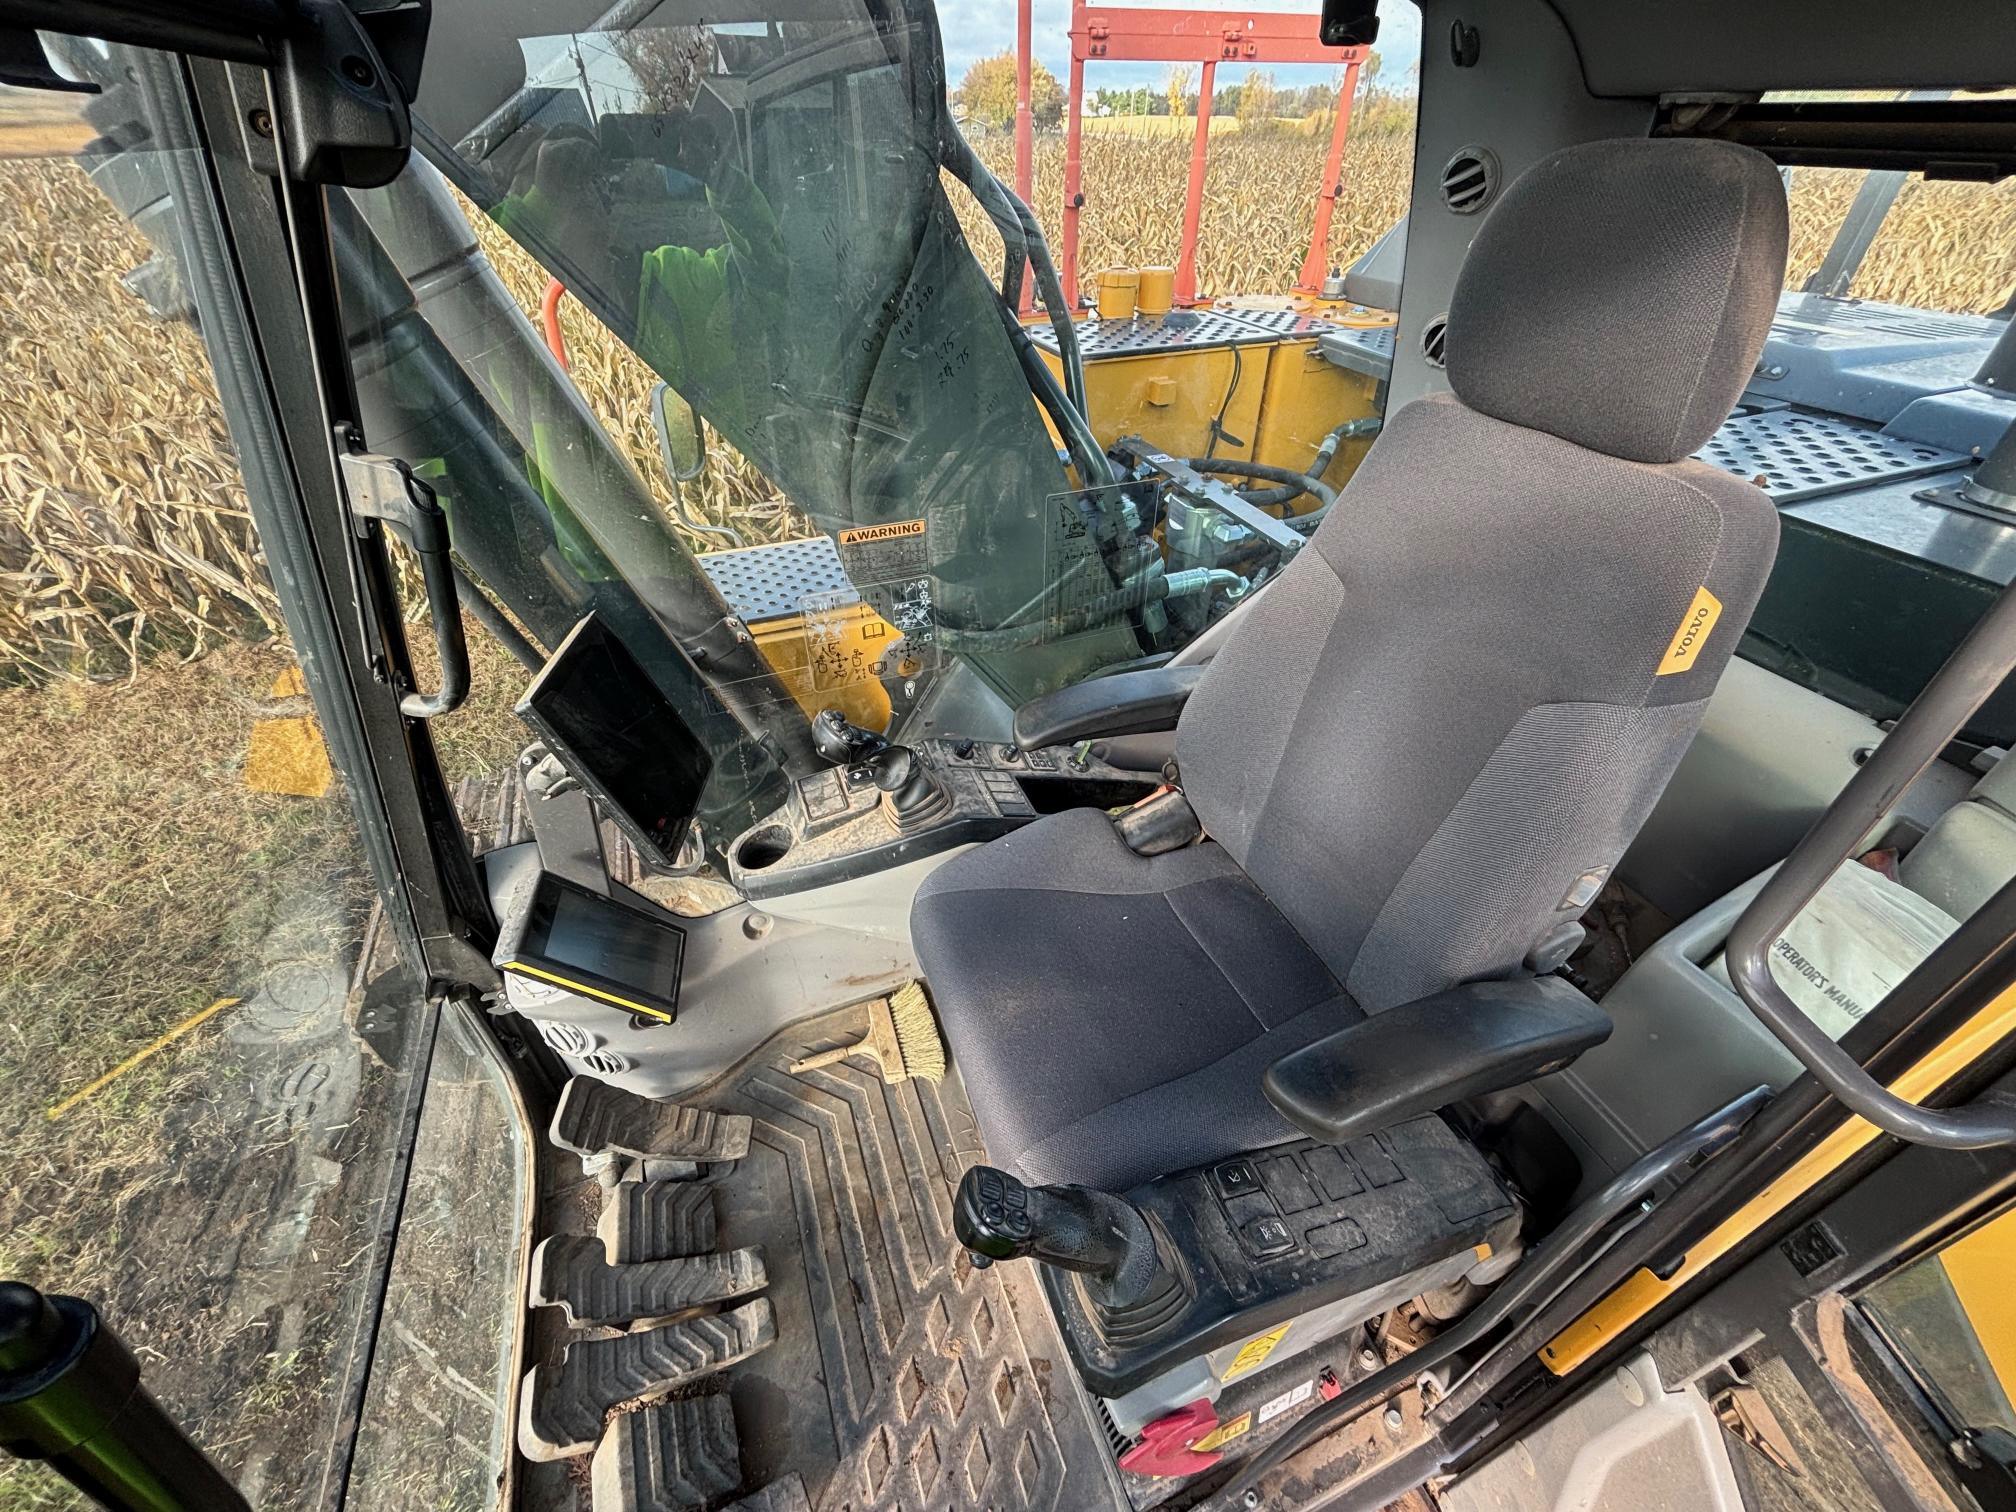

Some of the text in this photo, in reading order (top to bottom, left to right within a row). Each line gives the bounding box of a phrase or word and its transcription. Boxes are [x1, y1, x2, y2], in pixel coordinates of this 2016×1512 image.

[857, 522, 921, 541] WARNING
[1673, 607, 1709, 658] VOLVO
[1772, 938, 1829, 989] OPERATOR'S
